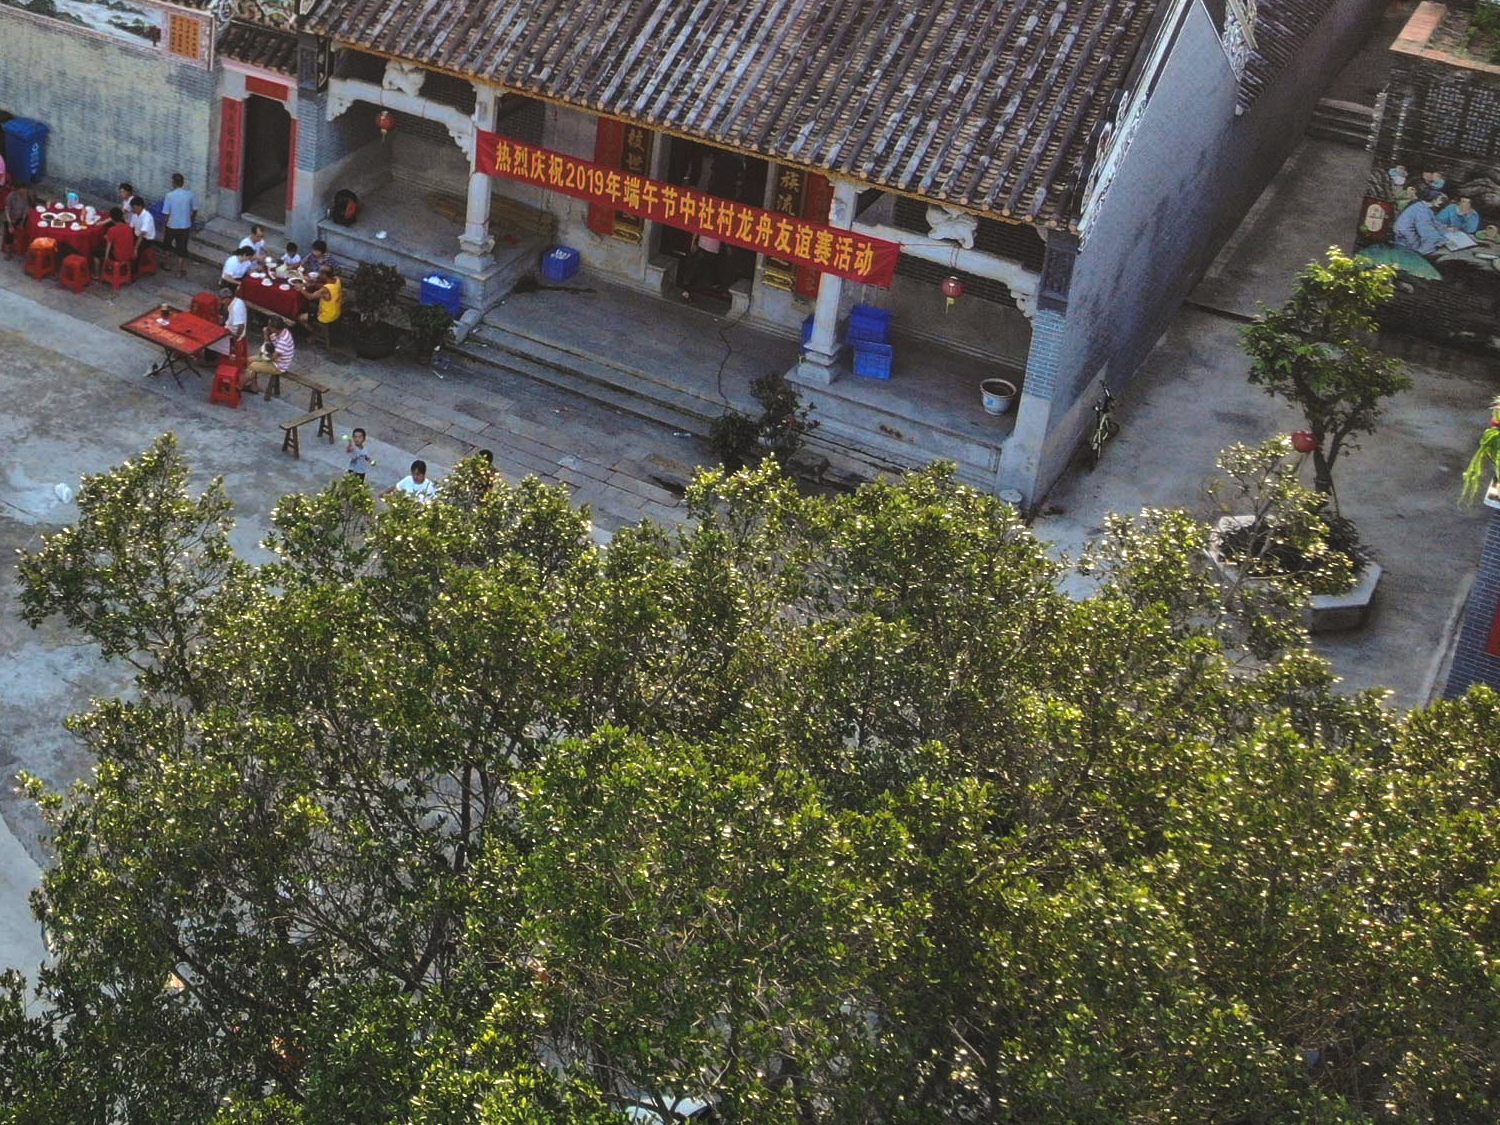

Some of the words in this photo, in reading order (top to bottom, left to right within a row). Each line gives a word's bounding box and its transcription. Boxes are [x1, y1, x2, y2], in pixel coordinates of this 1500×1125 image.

[495, 141, 874, 276] 热烈庆祝2019年端午节中社村龙舟友谊赛活动
